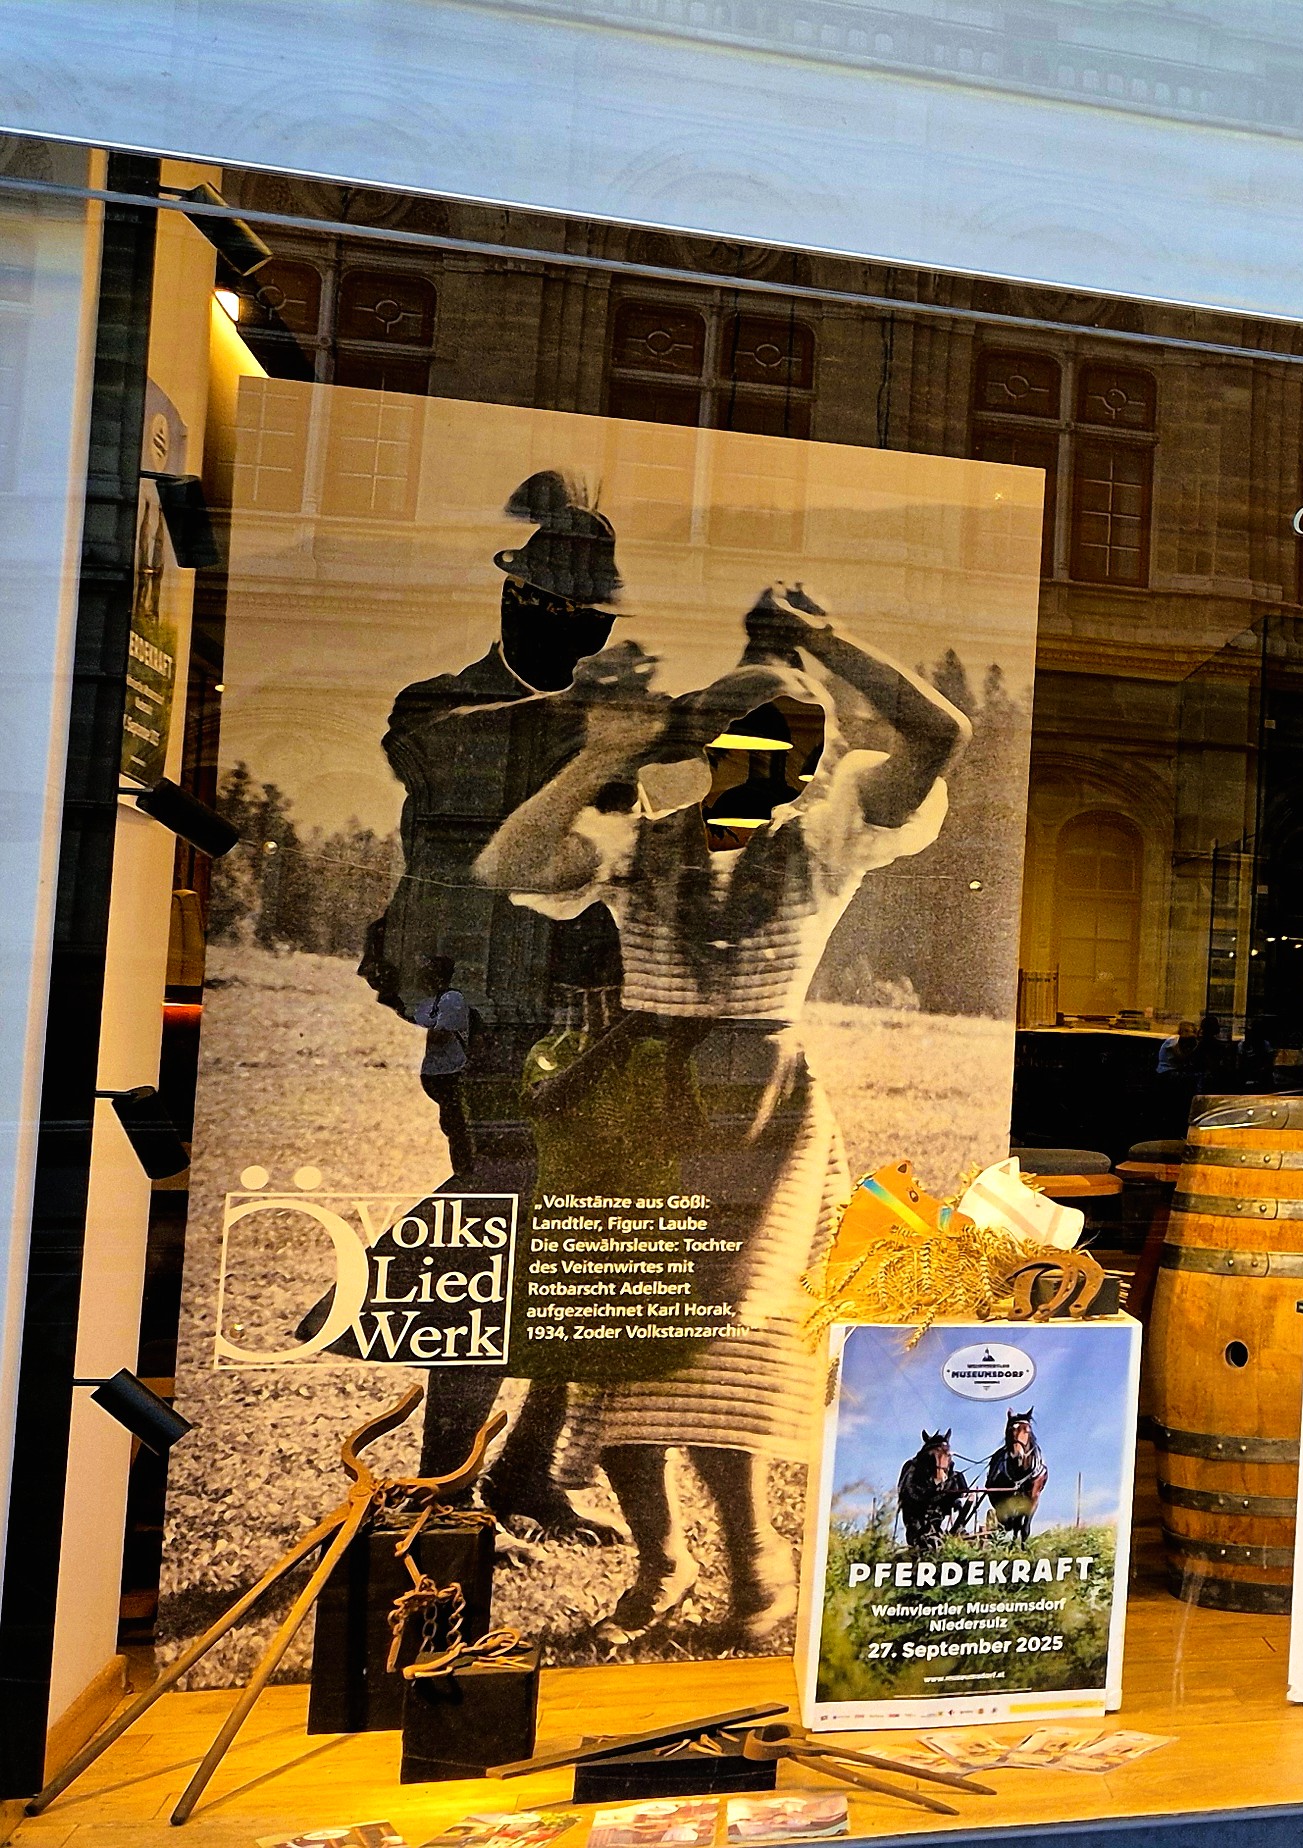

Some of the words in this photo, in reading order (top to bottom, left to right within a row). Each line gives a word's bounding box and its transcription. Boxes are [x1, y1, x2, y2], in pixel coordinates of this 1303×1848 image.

[636, 1198, 663, 1210] aus
[667, 1194, 711, 1210] Gößl:
[350, 1200, 508, 1248] Volks
[532, 1216, 604, 1233] Landtler,
[608, 1217, 654, 1234] Figur:
[659, 1217, 708, 1231] Laube
[530, 1238, 559, 1253] Die
[563, 1238, 680, 1253] Gewährsleute:
[684, 1238, 744, 1252] Tochter
[529, 1260, 558, 1274] des
[562, 1260, 663, 1274] Veitenwirtes
[668, 1260, 695, 1273] mit
[370, 1254, 504, 1304] Lied
[528, 1281, 616, 1296] Rotbarscht
[620, 1281, 691, 1295] Adelbert
[527, 1303, 643, 1321] aufgezeichnet
[647, 1303, 680, 1317] Karl
[685, 1302, 737, 1318] Horak,
[352, 1309, 502, 1359] Werk
[526, 1326, 569, 1341] 1934,
[573, 1325, 622, 1340] Zoder
[848, 1557, 1094, 1588] PFERDEKRAFT
[871, 1602, 963, 1617] Weinviertler
[966, 1598, 1067, 1615] Museumsdorf
[929, 1616, 1008, 1632] Niedersulz
[867, 1642, 897, 1659] 27.
[901, 1638, 1012, 1661] September
[1016, 1636, 1064, 1653] 2025
